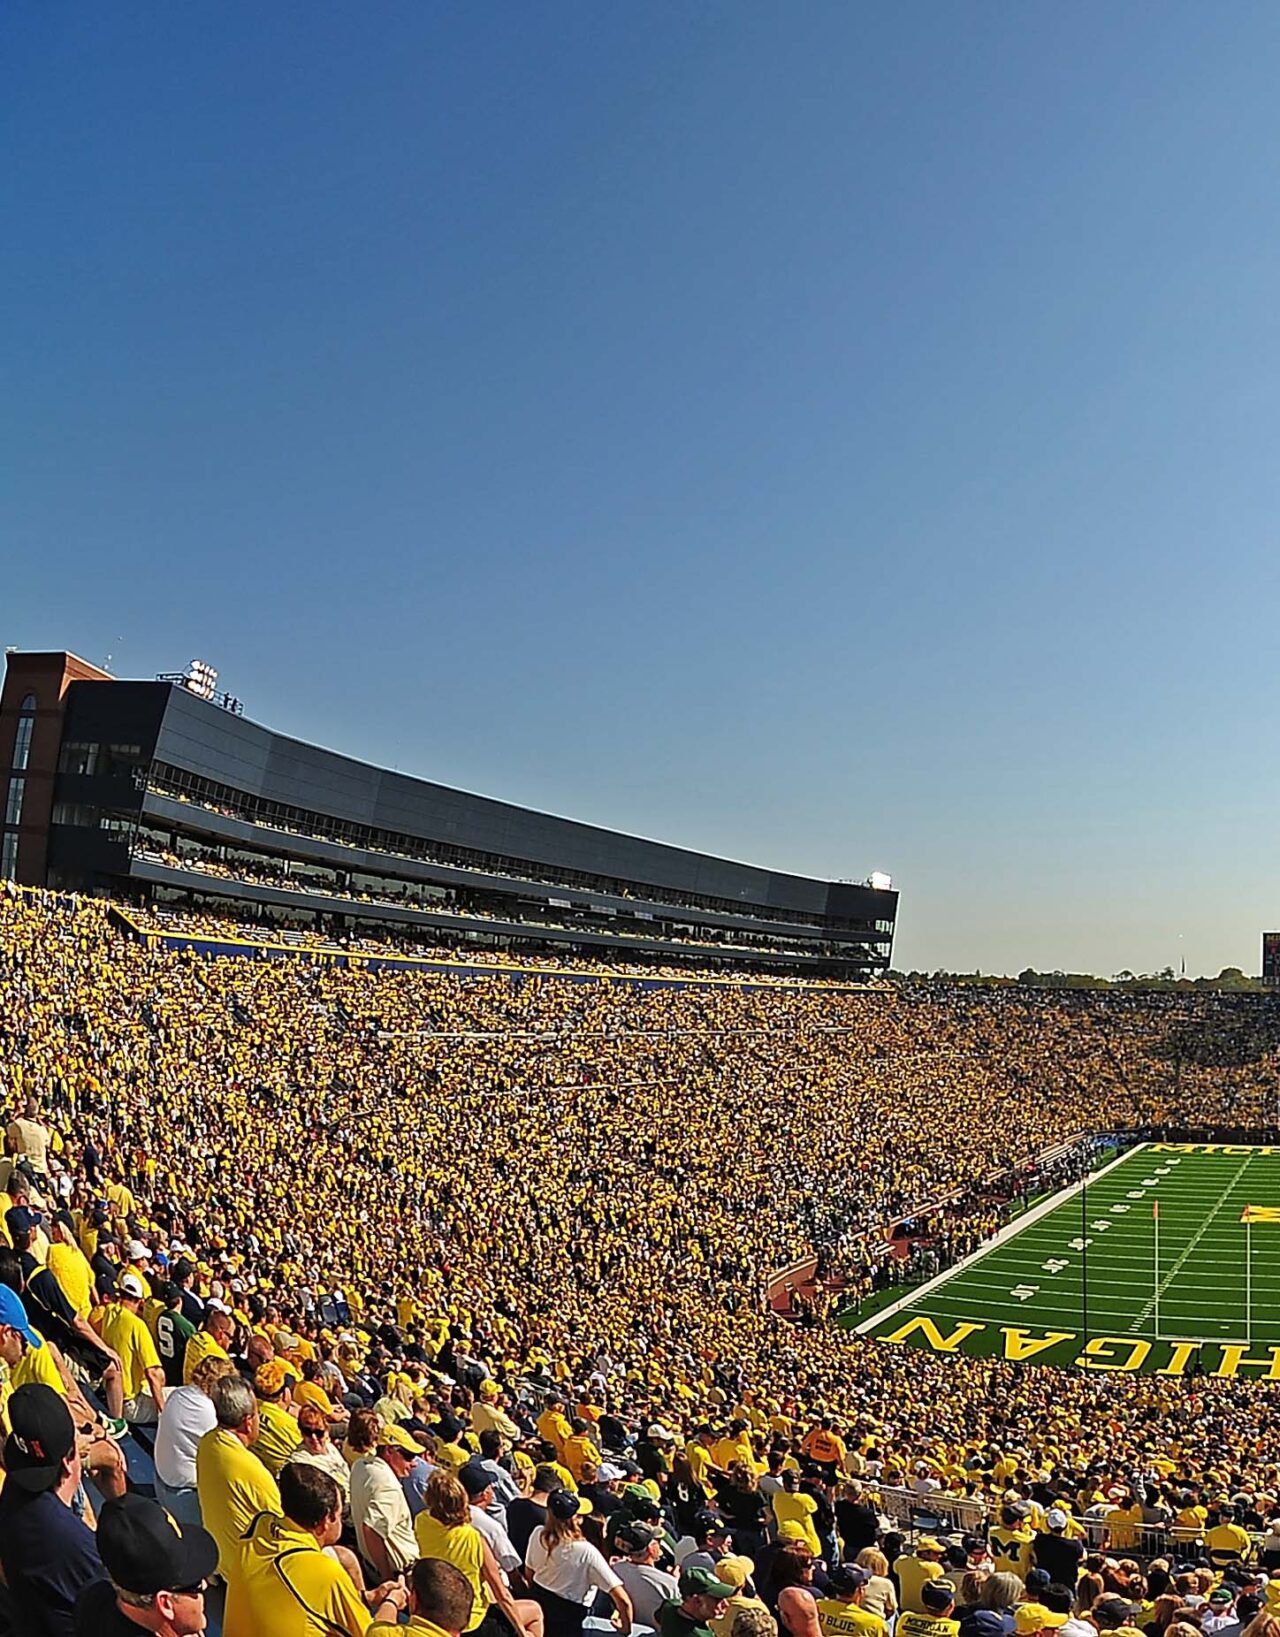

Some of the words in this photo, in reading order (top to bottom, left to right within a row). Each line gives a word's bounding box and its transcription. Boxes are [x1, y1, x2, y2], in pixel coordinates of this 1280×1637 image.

[157, 1315, 175, 1359] S
[992, 1536, 1021, 1562] M
[826, 1615, 856, 1633] BLUE
[905, 1616, 950, 1633] MICHIGAN
